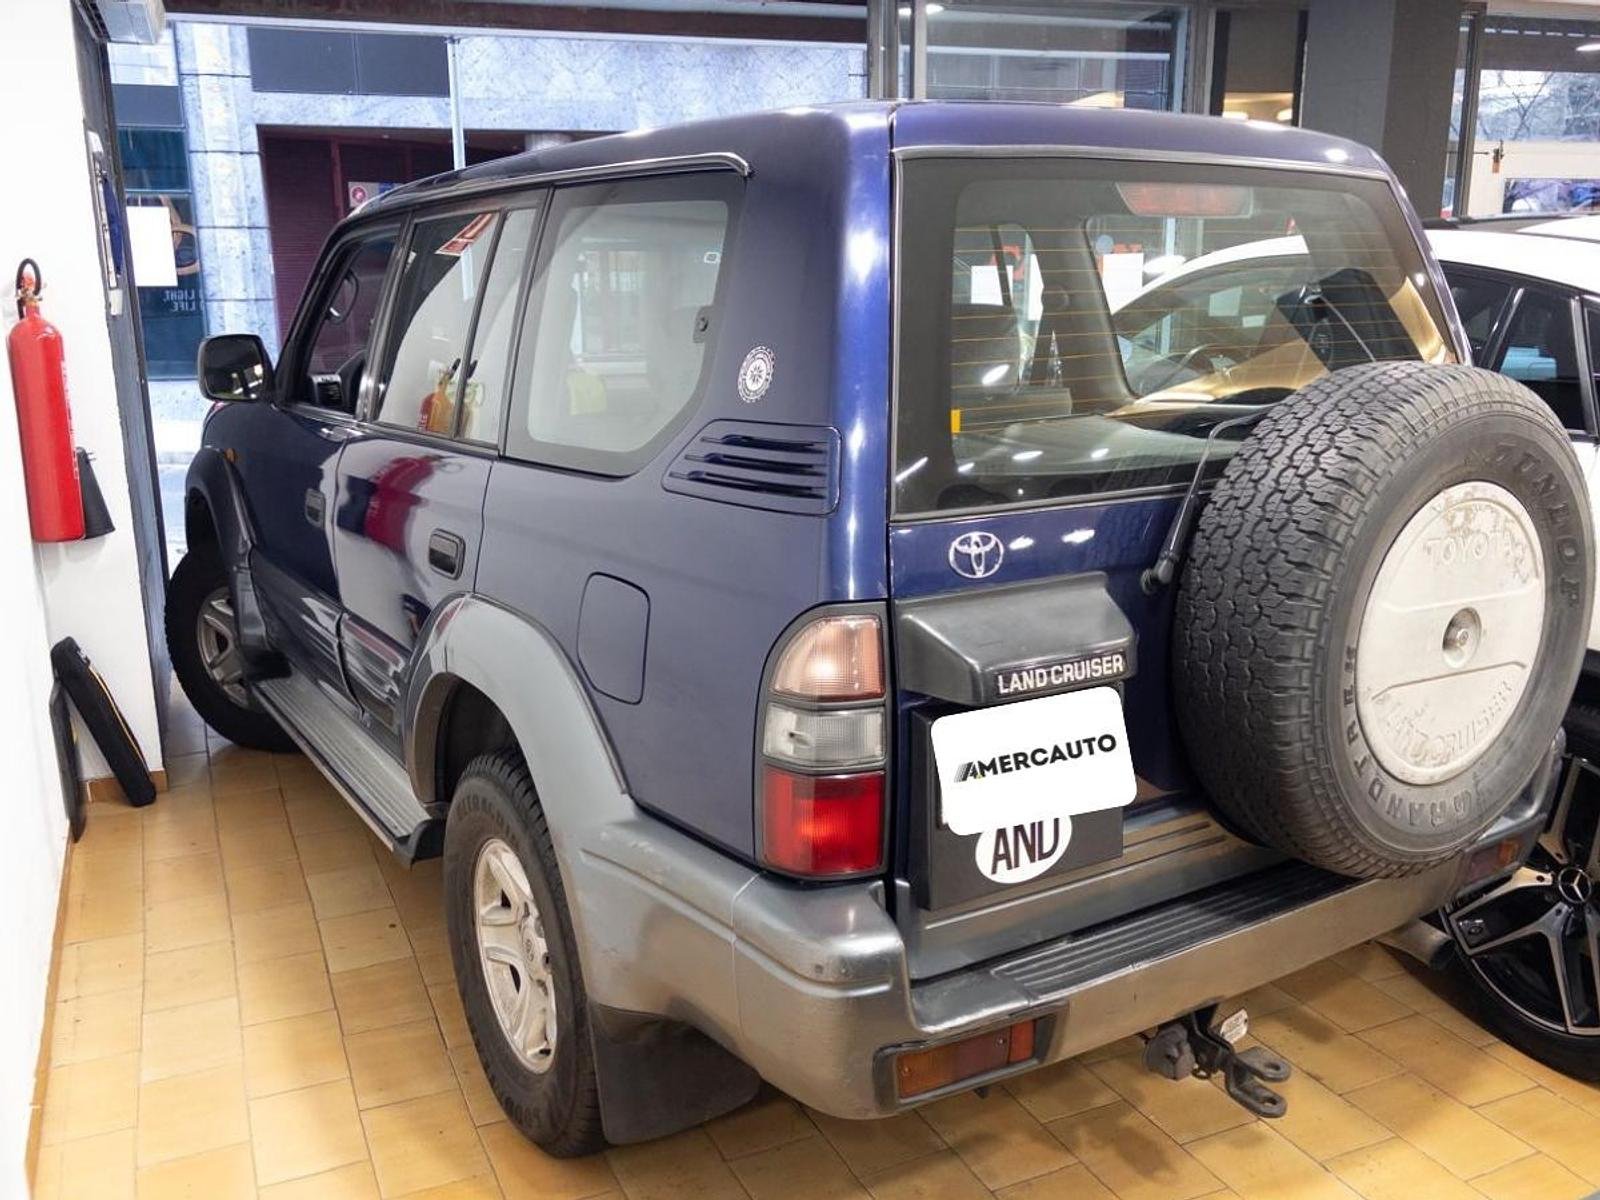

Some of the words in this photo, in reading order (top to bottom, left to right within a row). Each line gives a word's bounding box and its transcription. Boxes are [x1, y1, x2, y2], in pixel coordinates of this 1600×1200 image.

[998, 668, 1048, 694] LAND
[1049, 653, 1125, 685] CRUISER
[991, 817, 1060, 875] AND
